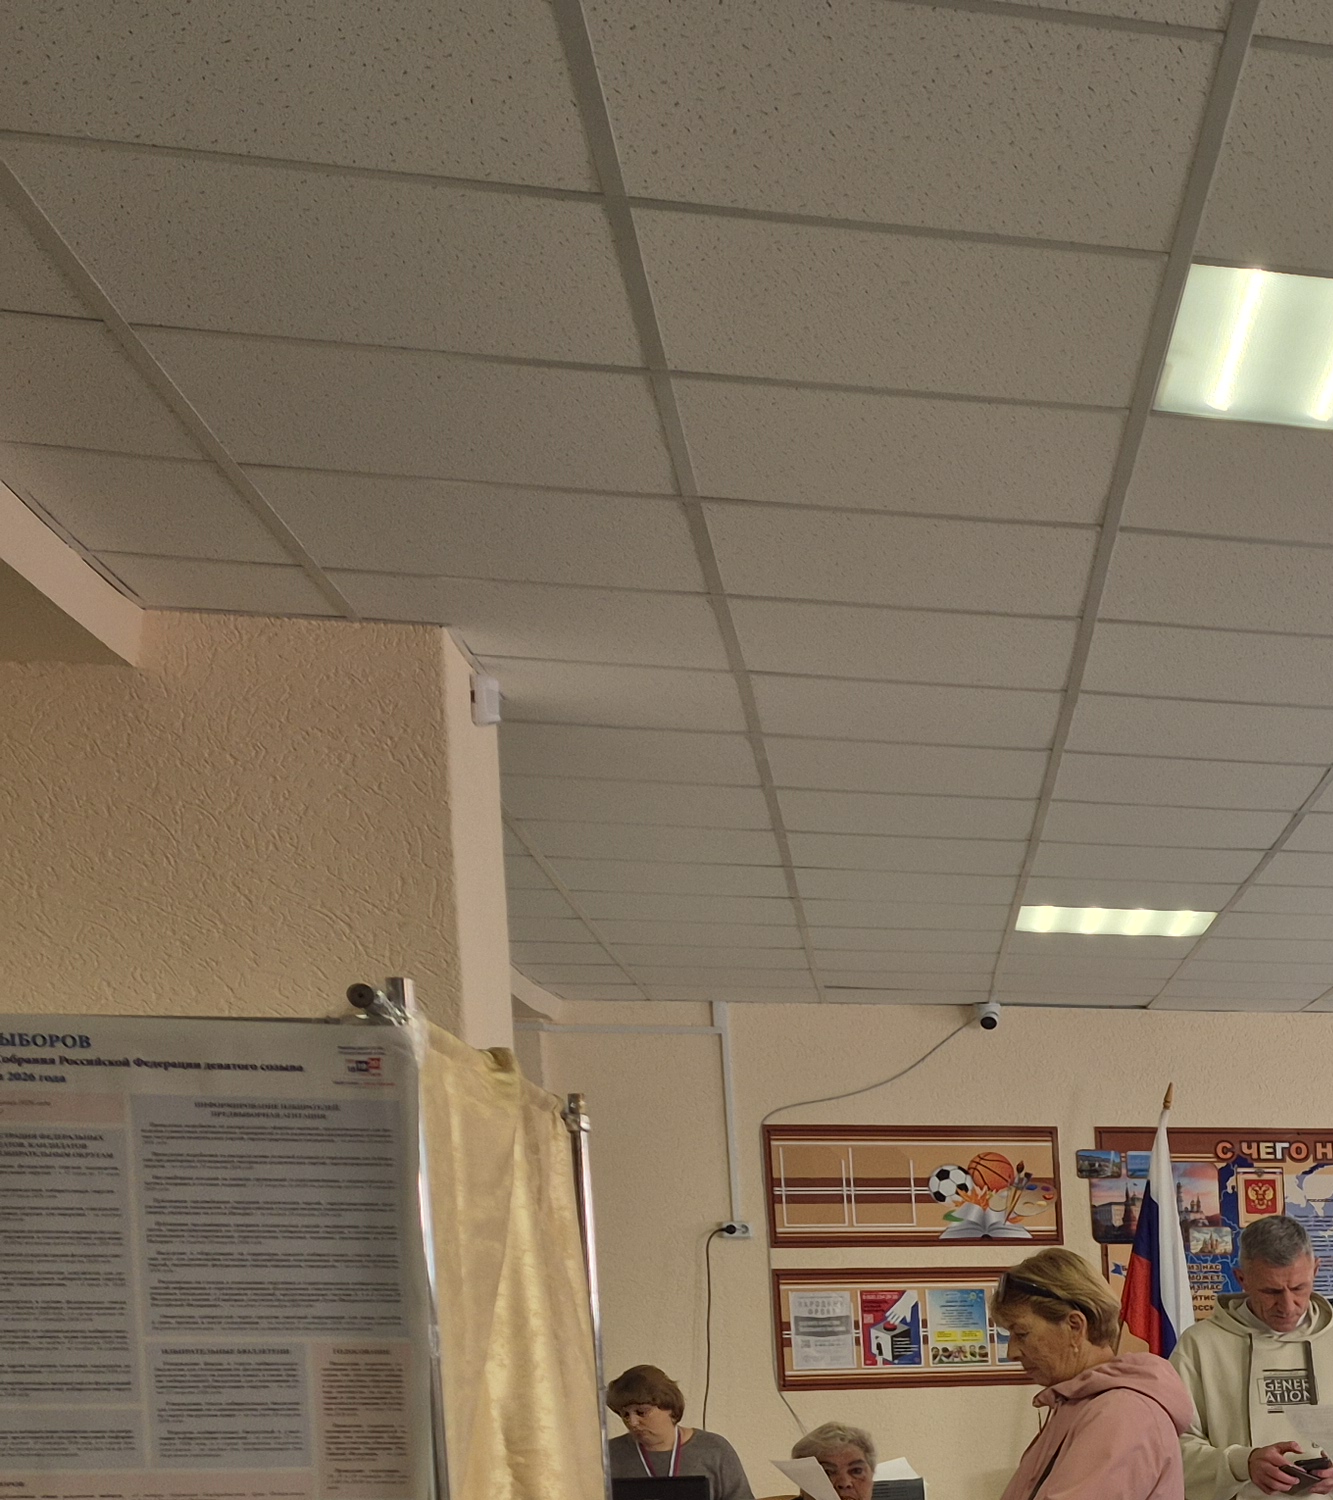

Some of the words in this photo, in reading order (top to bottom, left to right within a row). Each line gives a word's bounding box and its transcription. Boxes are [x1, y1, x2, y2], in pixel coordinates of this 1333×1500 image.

[0, 1053, 56, 1067] обрания
[1216, 1142, 1234, 1159] С
[1241, 1141, 1309, 1160] ЧЕГО
